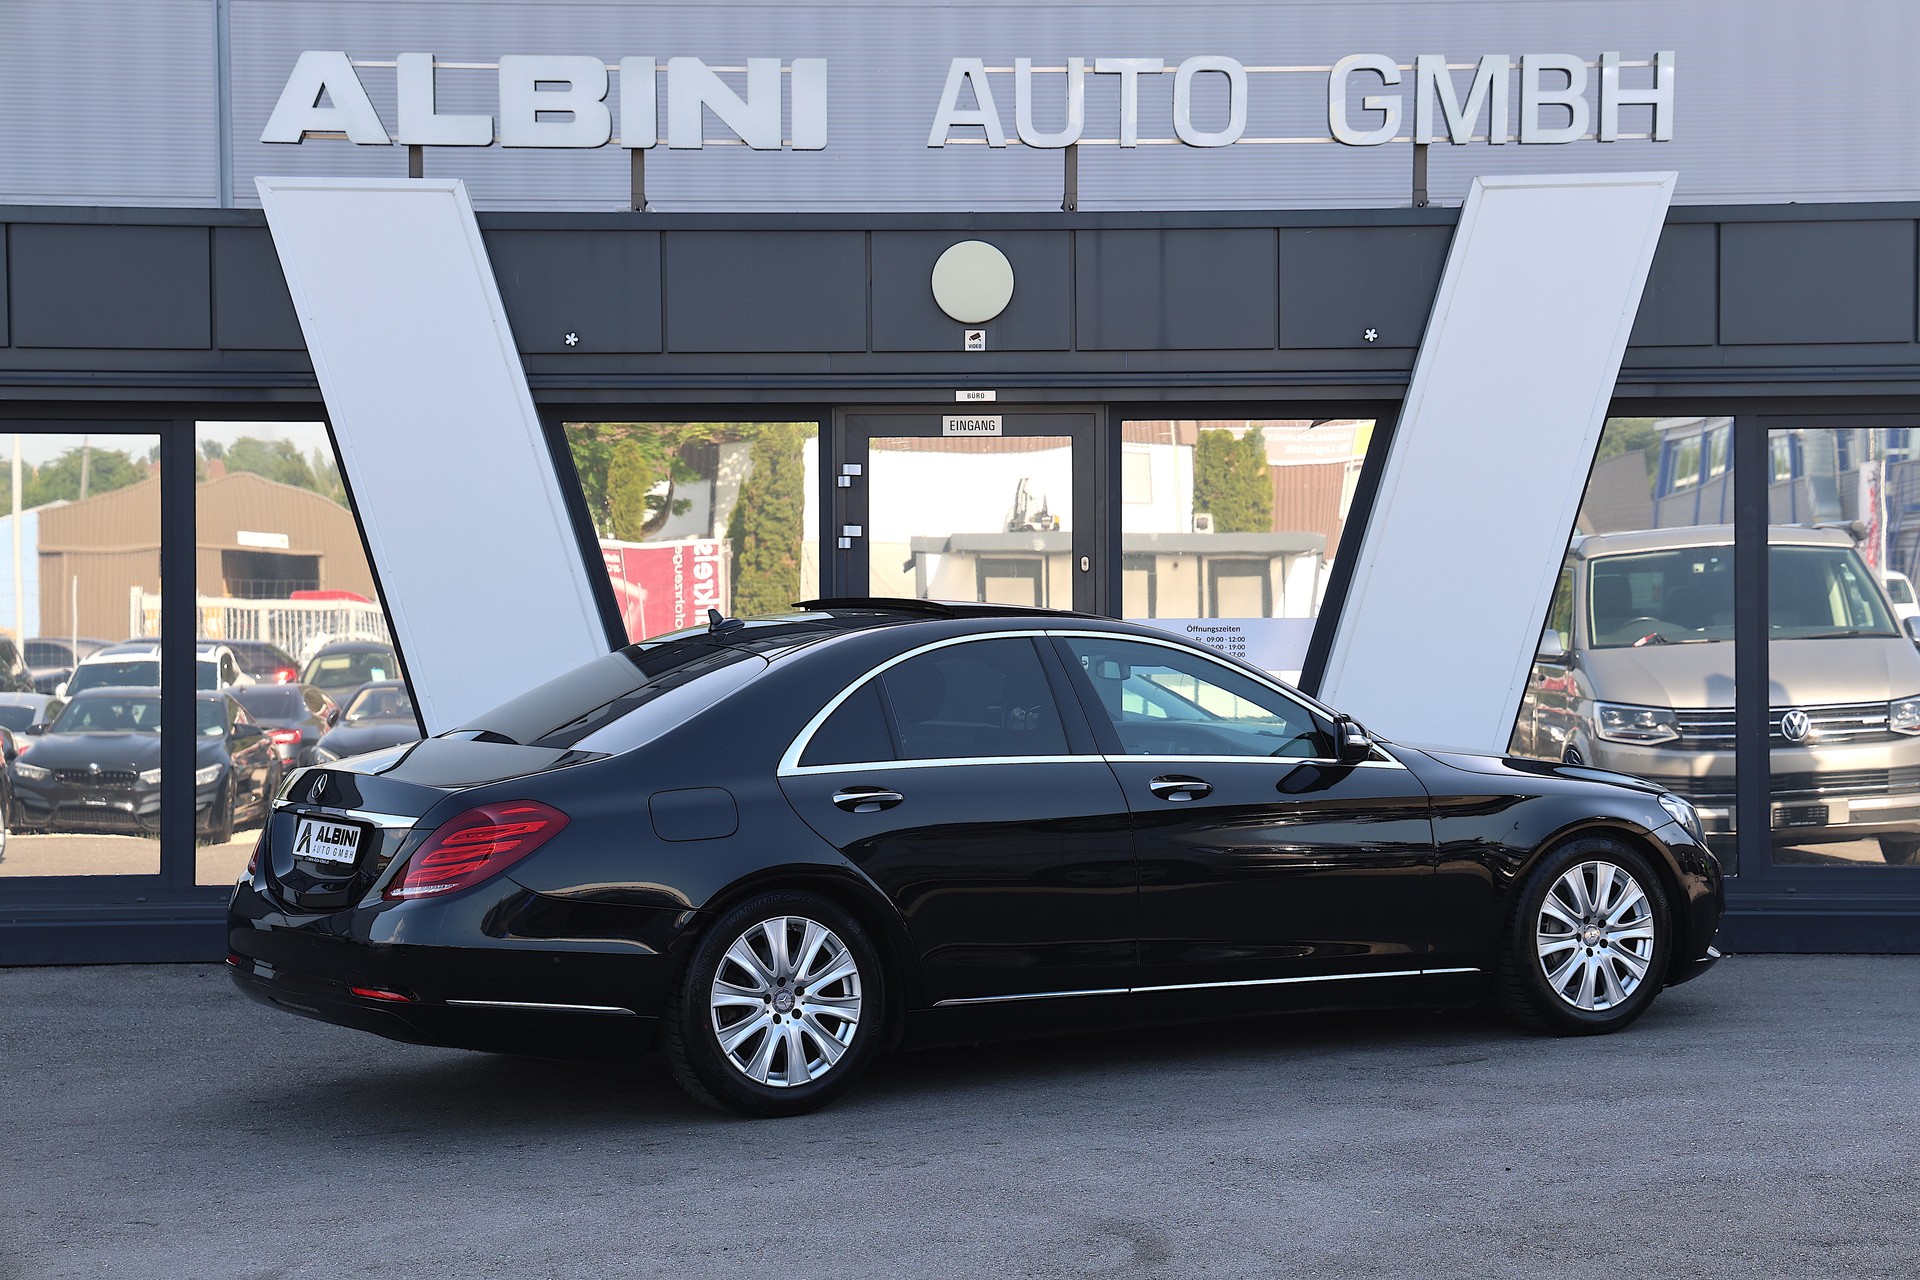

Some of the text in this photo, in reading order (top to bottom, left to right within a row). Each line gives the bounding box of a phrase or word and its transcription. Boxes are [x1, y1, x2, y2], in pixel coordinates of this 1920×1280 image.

[260, 50, 1676, 151] ALBINI AUTO GMBH
[949, 420, 995, 431] EINGANG
[1186, 624, 1241, 633] Öffnungszeiten
[315, 825, 359, 847] ALBINI
[312, 844, 355, 860] AUTO GMBH
[725, 894, 782, 927] WINGUARD
